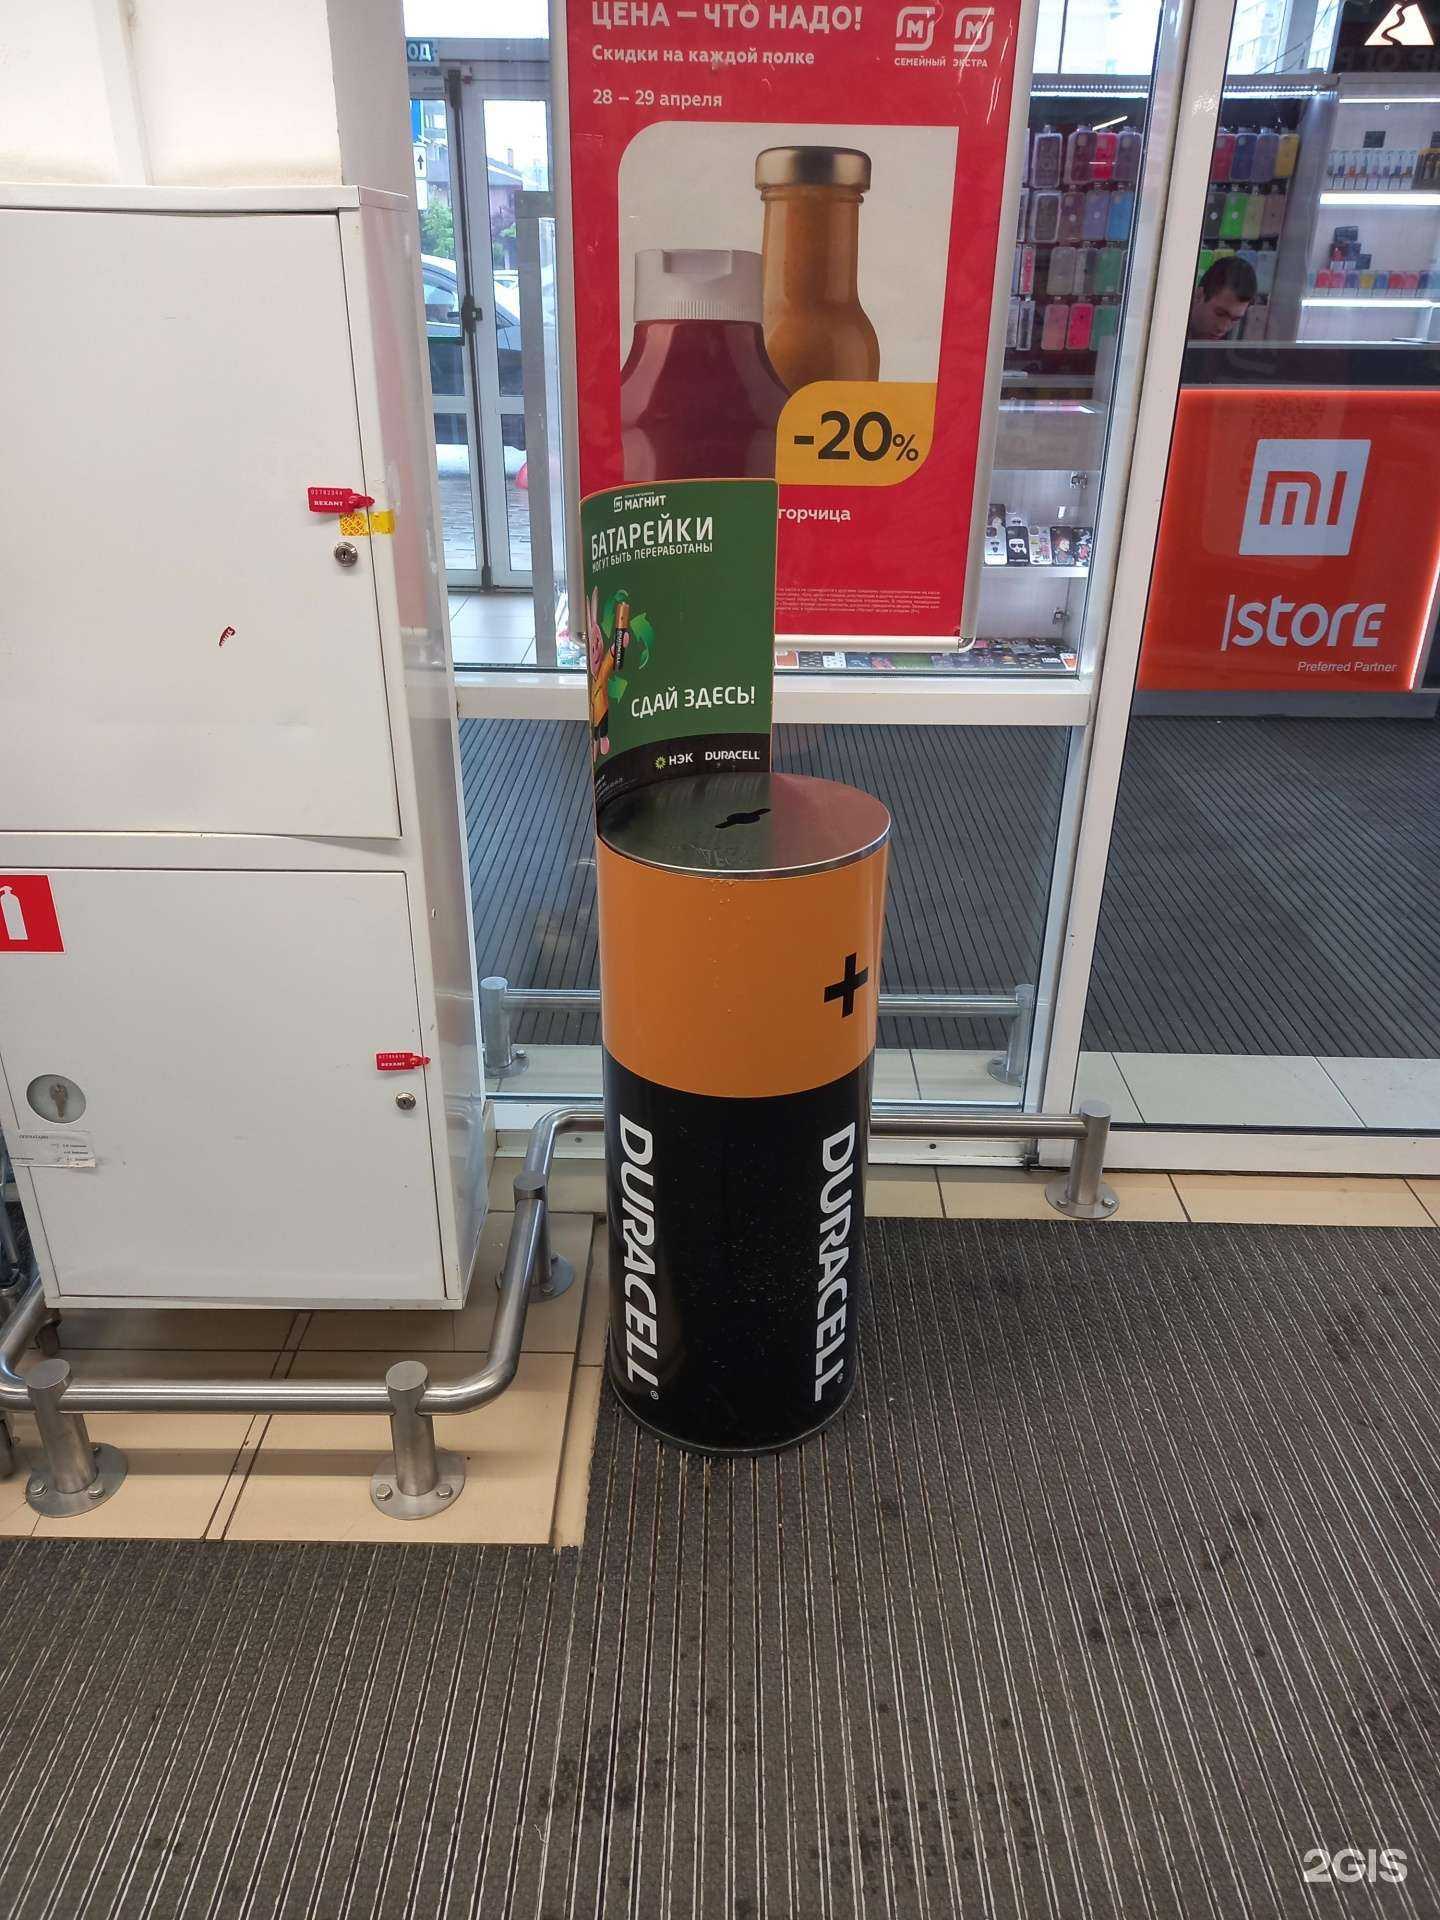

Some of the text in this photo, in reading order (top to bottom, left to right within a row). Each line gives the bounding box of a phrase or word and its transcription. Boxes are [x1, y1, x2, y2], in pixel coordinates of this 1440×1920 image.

[592, 0, 670, 30] ЦЕНА
[703, 2, 761, 29] ЧТО
[768, 5, 862, 34] НАДО!
[592, 45, 815, 67] Скидки на каждой полке
[894, 56, 946, 68] СЕМЕЙНЫЙ
[592, 89, 612, 105] 28
[635, 90, 655, 106] 29
[659, 93, 722, 108] апреля
[794, 410, 920, 462] -20%
[624, 495, 666, 510] МАГНИТ
[779, 508, 851, 523] горчица
[591, 513, 713, 561] БАТАРЕЙКИ
[611, 551, 632, 566] БЫТЬ
[634, 542, 713, 561] ПЕРЕРАБОТАНЫ
[1298, 661, 1397, 672] Preferred Partner
[631, 686, 755, 718] СДАЙ ЗДЕСЬ!
[669, 753, 693, 766] НЭК
[705, 750, 760, 761] DURACELL
